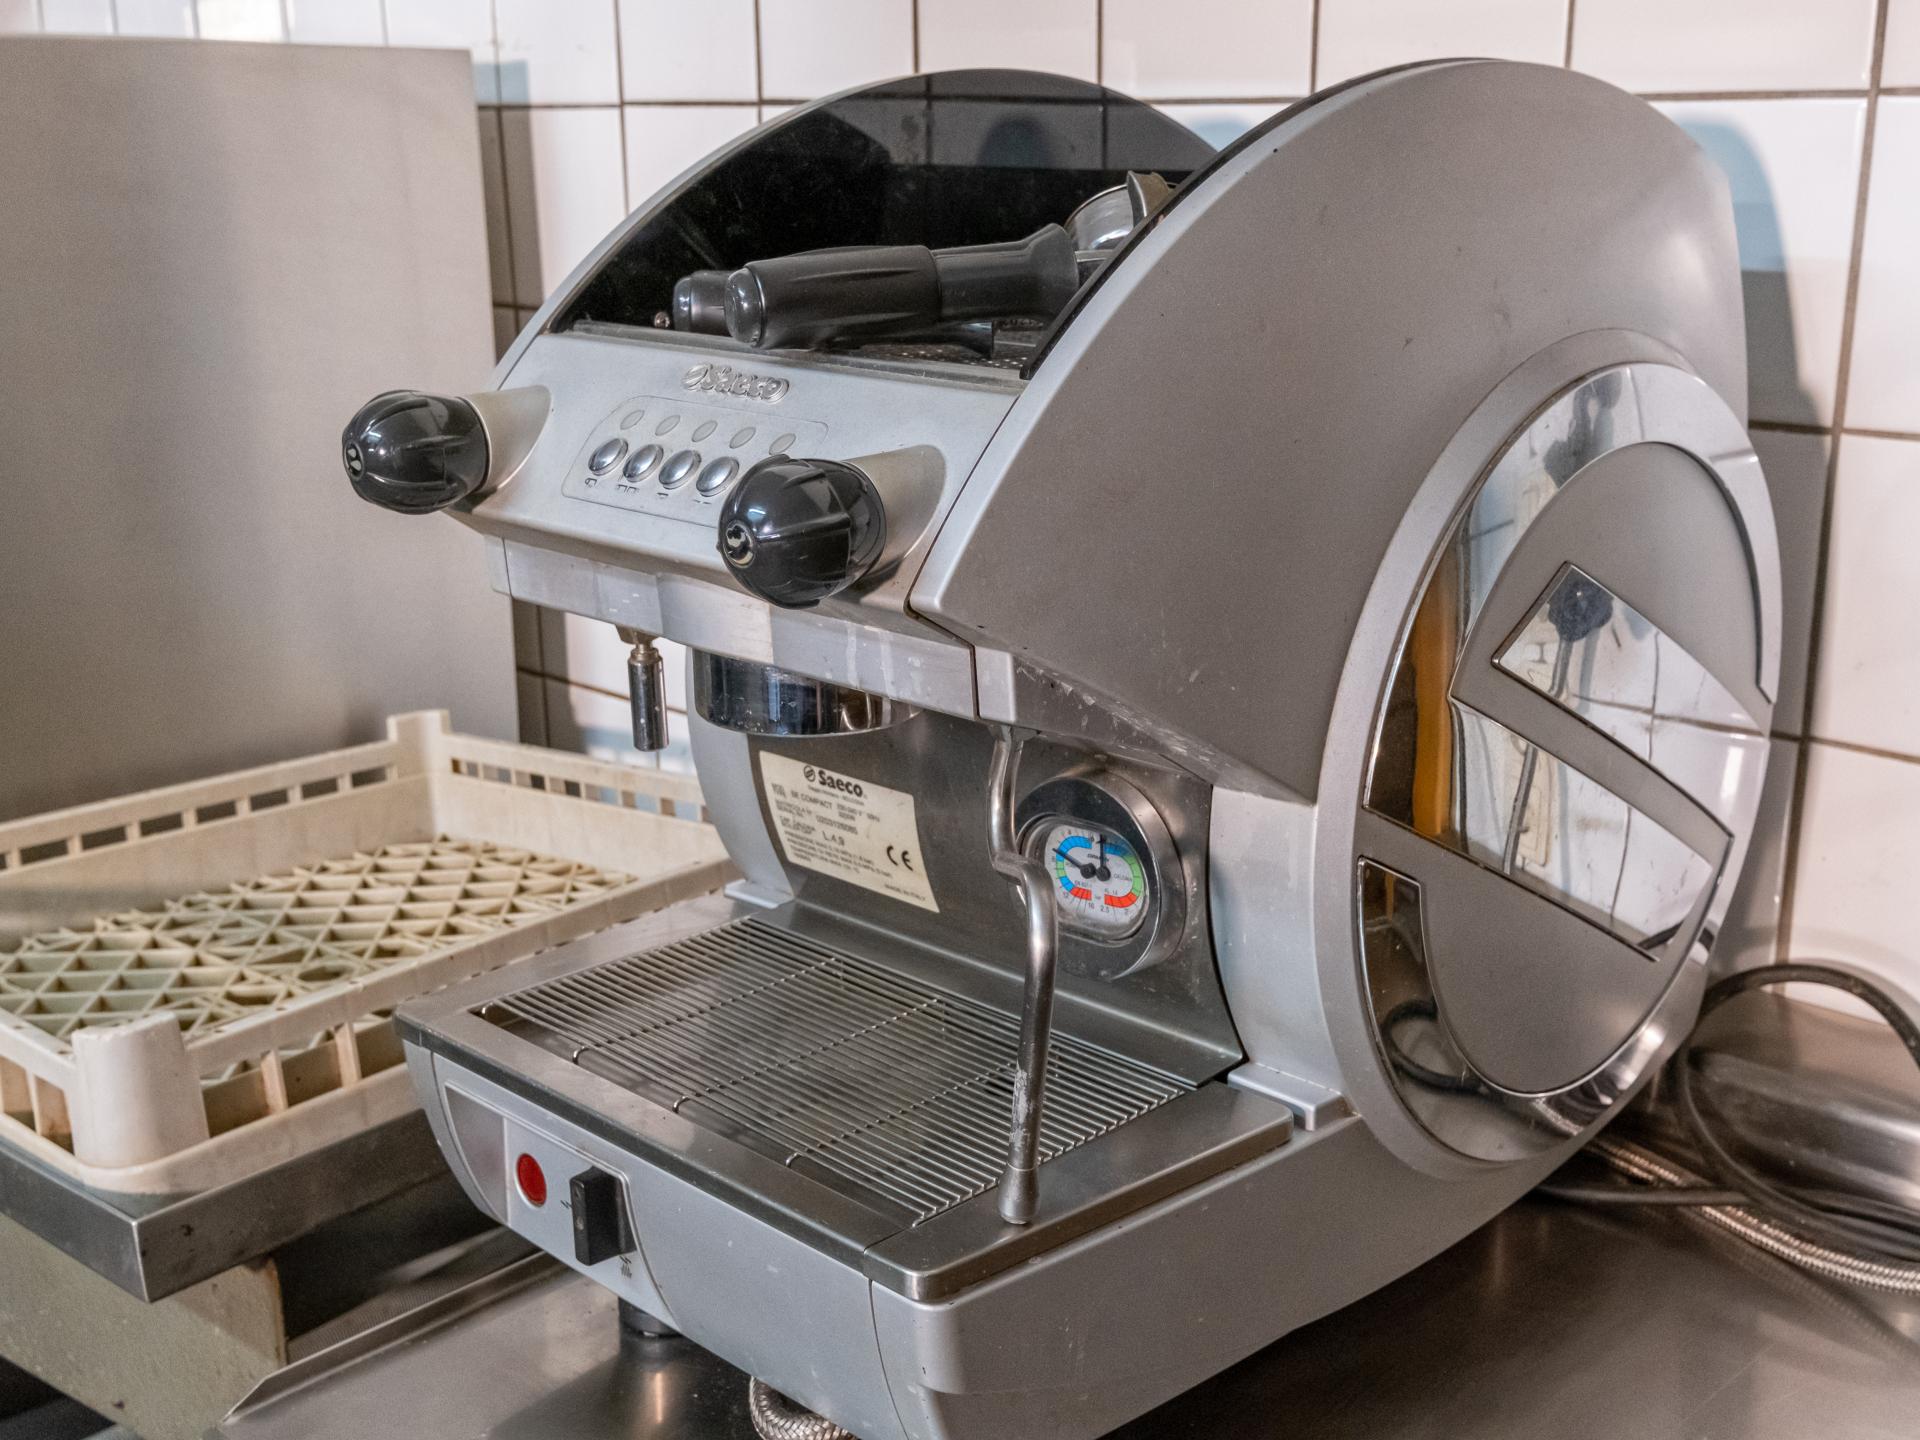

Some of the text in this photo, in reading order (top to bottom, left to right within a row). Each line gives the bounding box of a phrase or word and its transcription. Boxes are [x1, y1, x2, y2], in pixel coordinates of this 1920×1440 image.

[700, 366, 789, 404] Saeco
[818, 769, 863, 798] Saeco
[886, 845, 914, 871] CE
